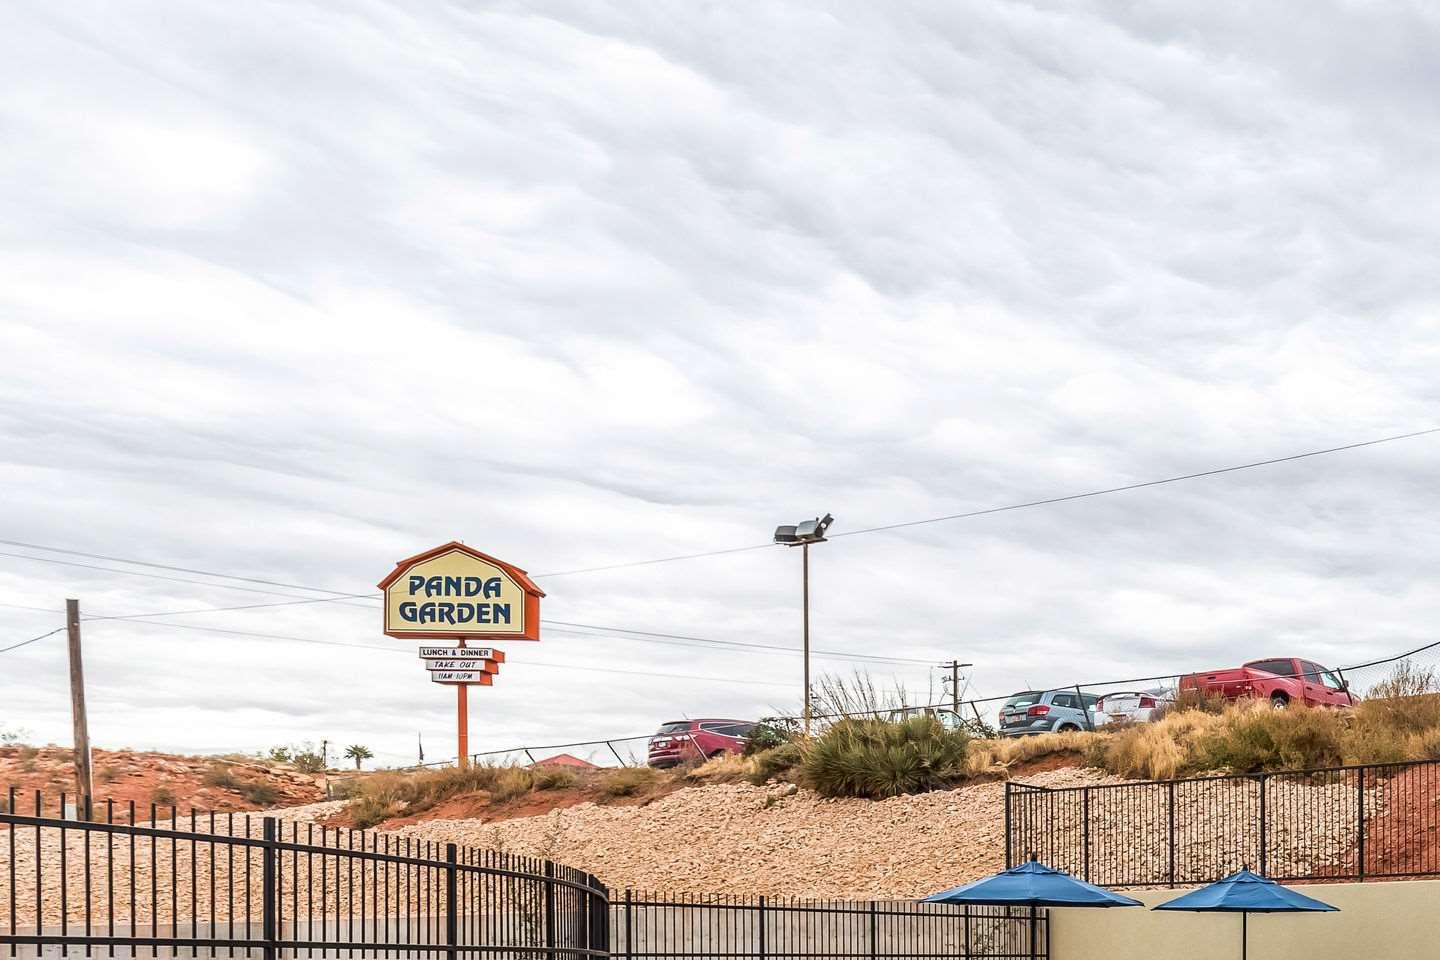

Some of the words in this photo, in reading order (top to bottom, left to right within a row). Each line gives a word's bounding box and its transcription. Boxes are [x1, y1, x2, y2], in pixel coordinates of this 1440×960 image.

[409, 576, 501, 599] PANDA
[399, 602, 510, 625] GARDEN
[460, 649, 489, 657] DINNER
